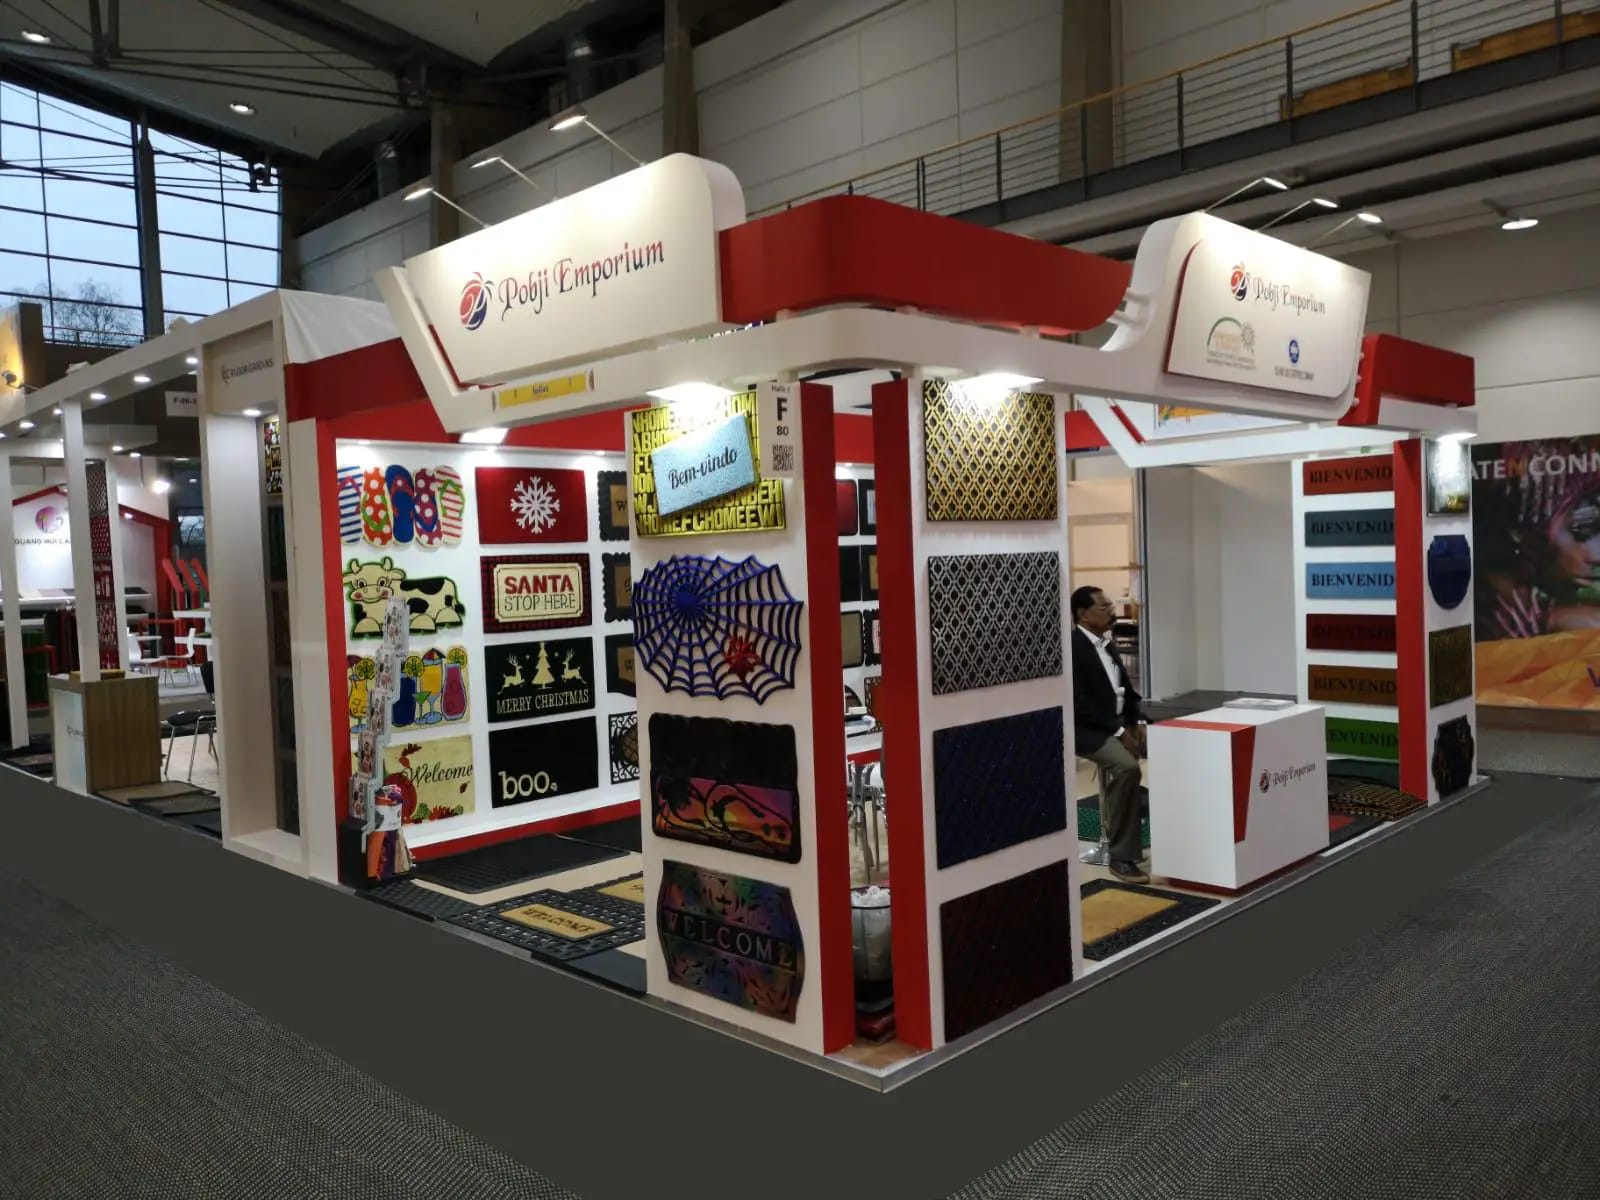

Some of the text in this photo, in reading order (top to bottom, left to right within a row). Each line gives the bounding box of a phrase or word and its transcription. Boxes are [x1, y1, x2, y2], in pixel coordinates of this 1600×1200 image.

[498, 240, 665, 322] Pobji Emporium
[1253, 277, 1326, 317] Pobji Emporium
[776, 397, 788, 421] F
[776, 426, 790, 437] 80
[667, 446, 738, 490] Bem-vindo
[1310, 467, 1393, 484] BIENVENID
[1311, 519, 1394, 536] BIENVENID
[504, 574, 574, 595] SANTA
[1312, 573, 1394, 587] BIENVENID
[504, 593, 576, 612] STOP HERE
[1314, 675, 1396, 694] BIENVENID
[496, 689, 589, 714] MERRY CHRISTMAS
[1327, 728, 1398, 746] ENVENID
[402, 762, 473, 788] Welcome
[663, 909, 793, 967] WELCOME
